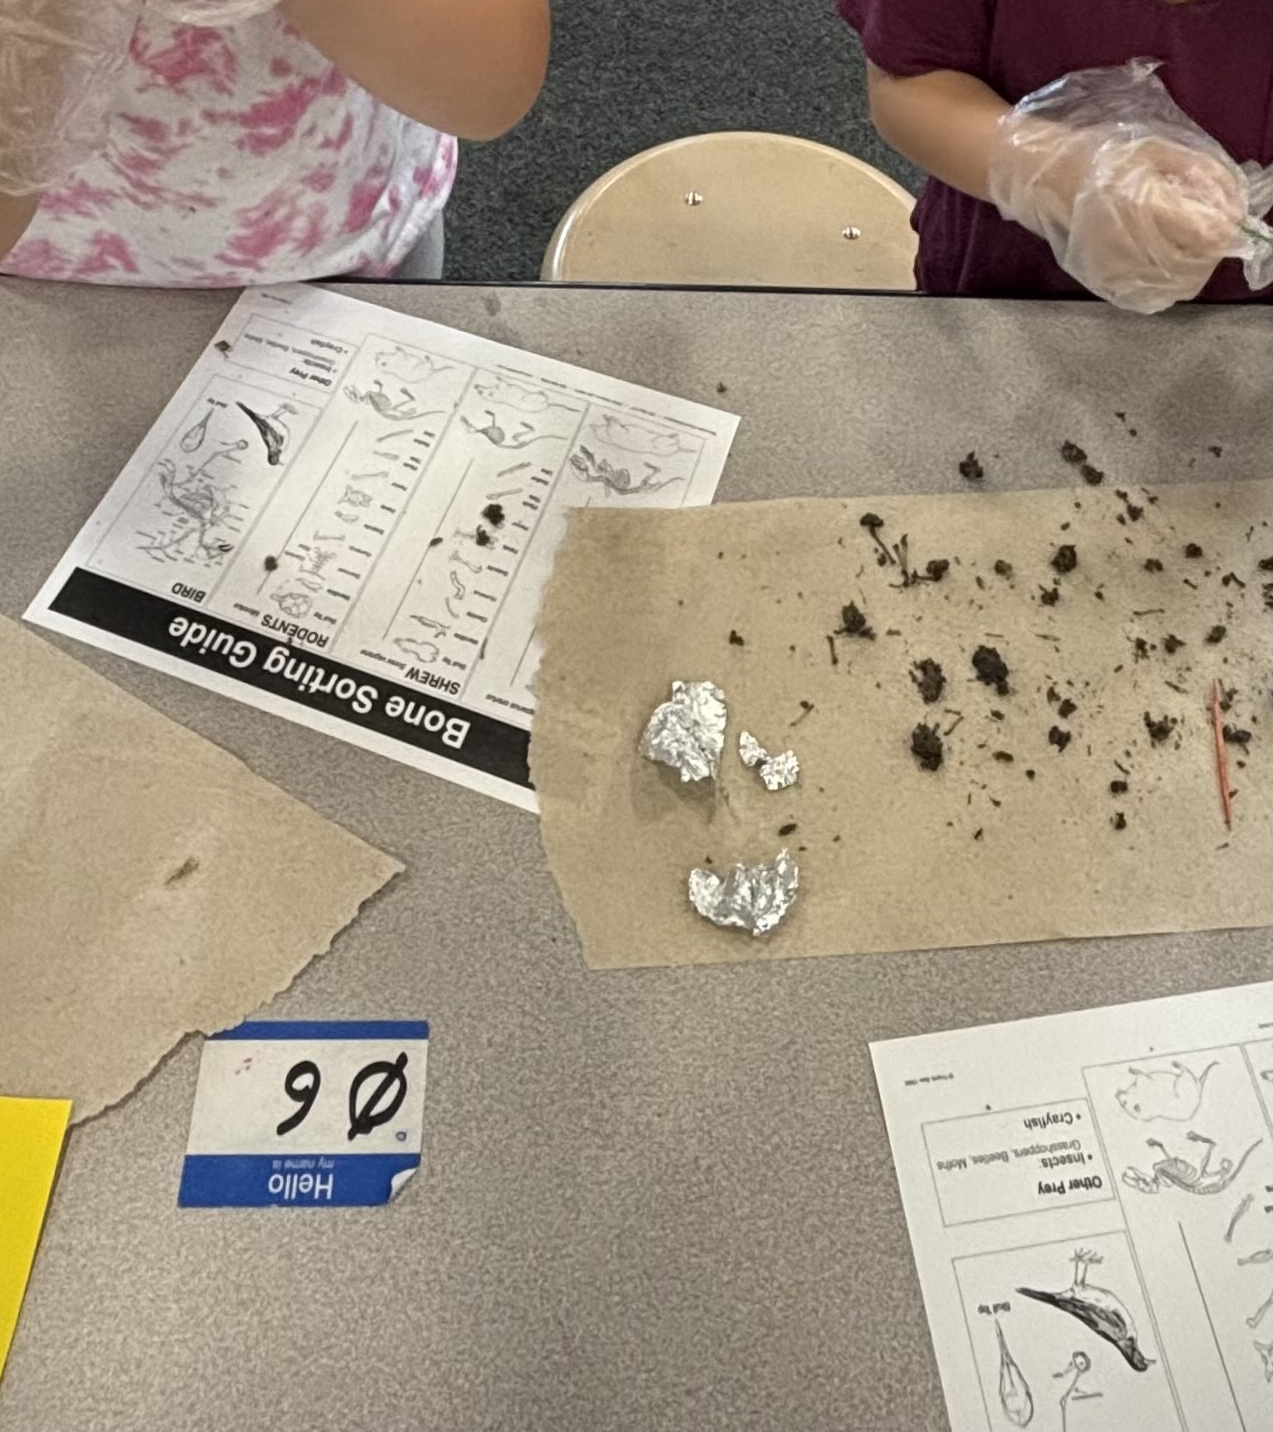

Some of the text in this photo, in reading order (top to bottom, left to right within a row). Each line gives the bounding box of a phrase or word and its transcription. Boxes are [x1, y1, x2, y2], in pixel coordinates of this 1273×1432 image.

[171, 582, 207, 603] BIRD
[261, 614, 330, 648] RODENTS
[168, 617, 471, 749] Bone Sorting Guide
[404, 666, 461, 695] SHREW
[1024, 1111, 1074, 1130] Crayfish
[284, 1159, 316, 1169] name
[268, 1173, 334, 1200] Hello
[1038, 1175, 1103, 1195] Other Prey
